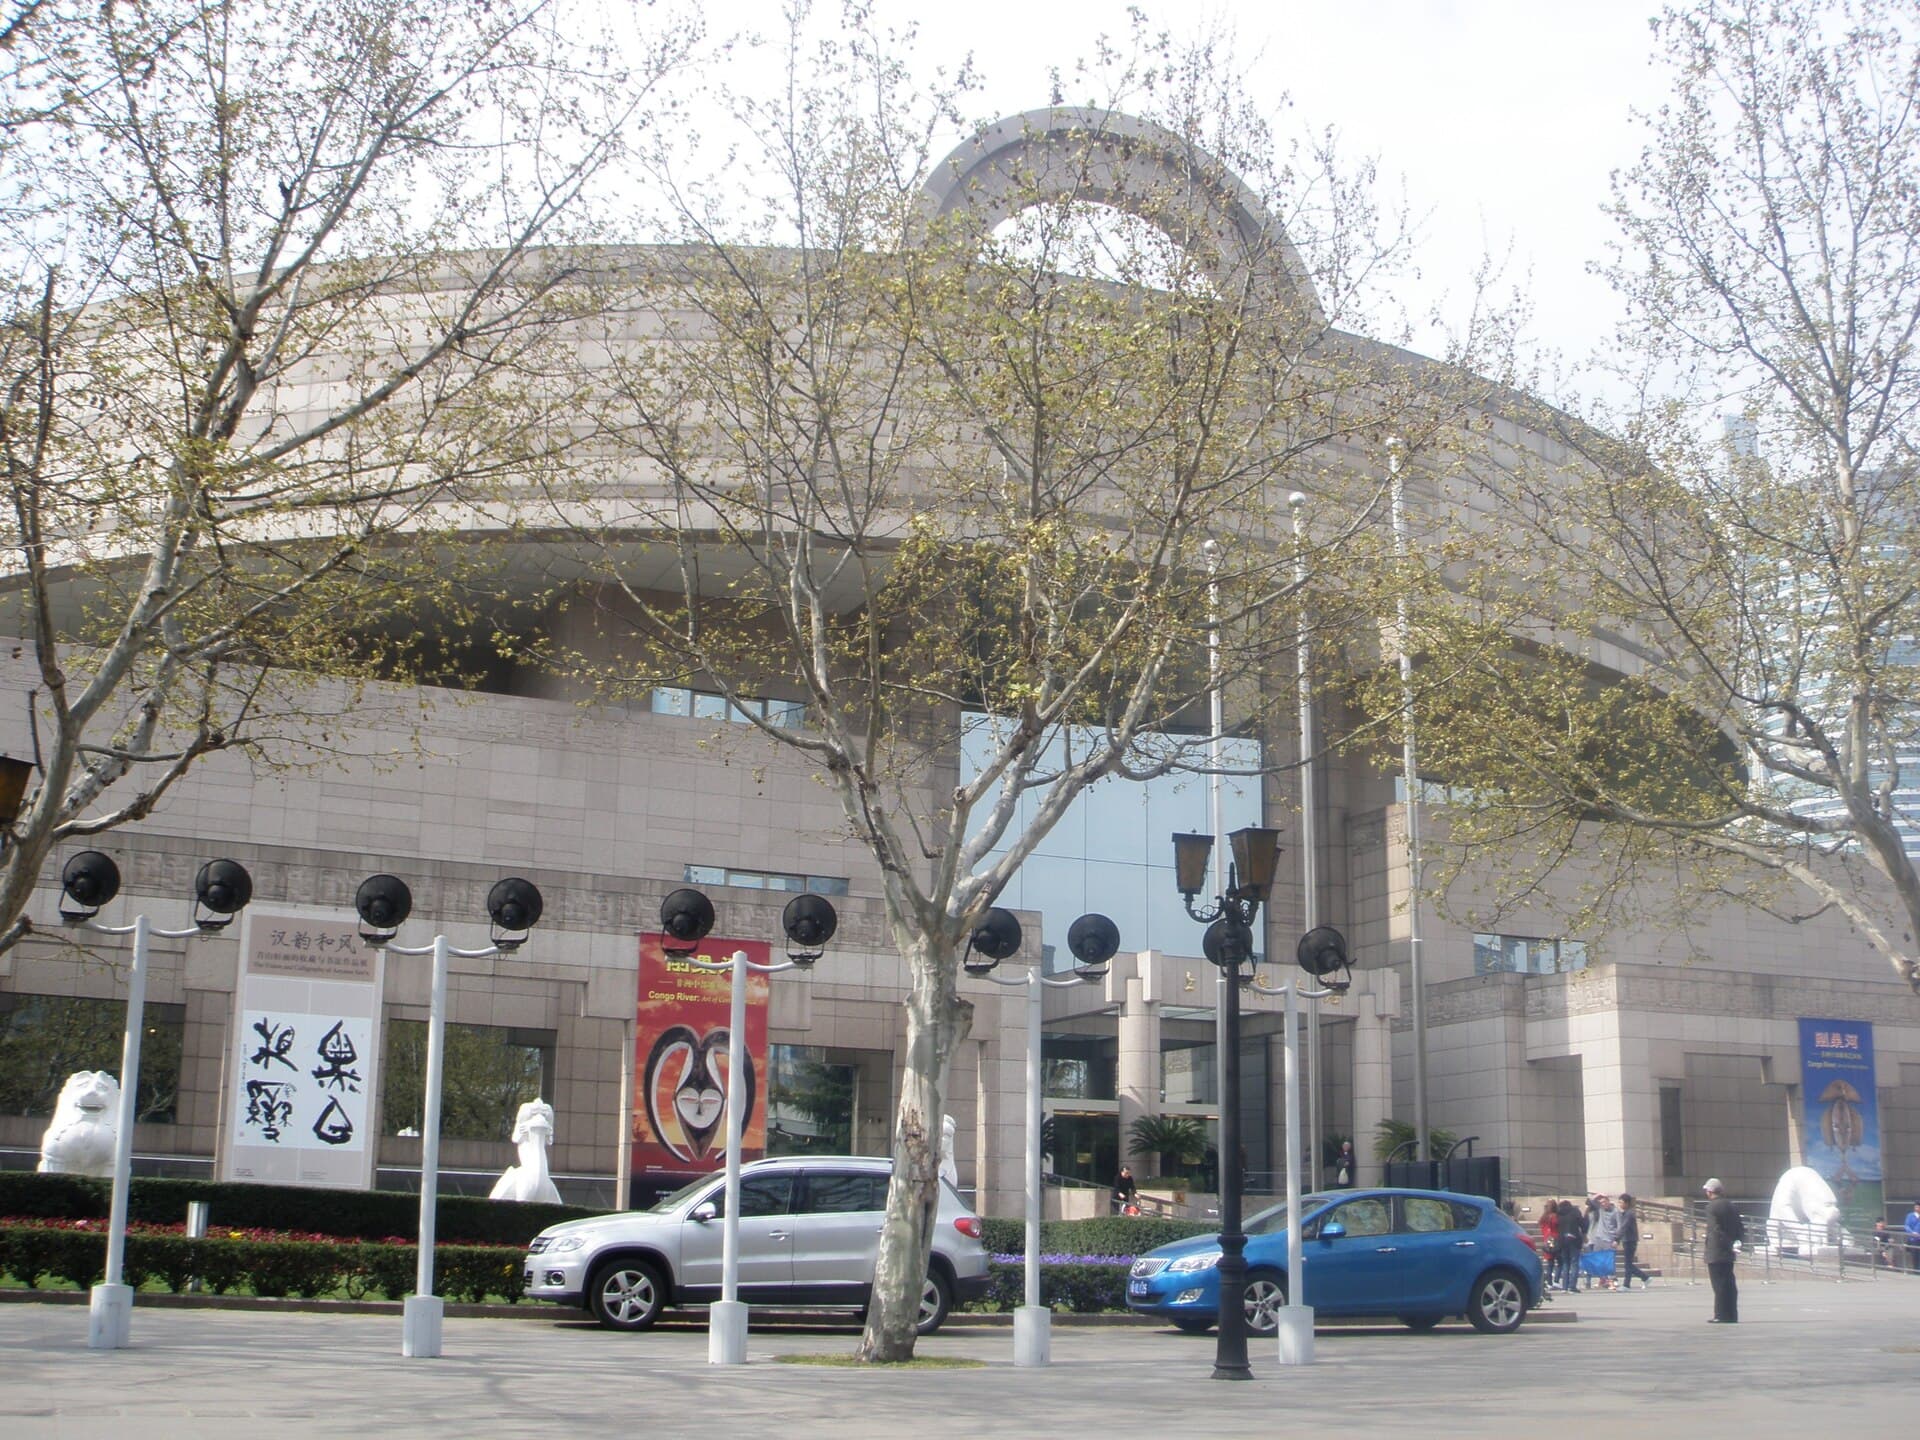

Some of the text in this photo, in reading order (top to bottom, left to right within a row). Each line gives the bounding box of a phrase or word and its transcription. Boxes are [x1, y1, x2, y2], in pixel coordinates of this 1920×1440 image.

[271, 929, 357, 955] 汉韵和风
[648, 990, 676, 1004] Congo
[676, 992, 700, 1002] River:
